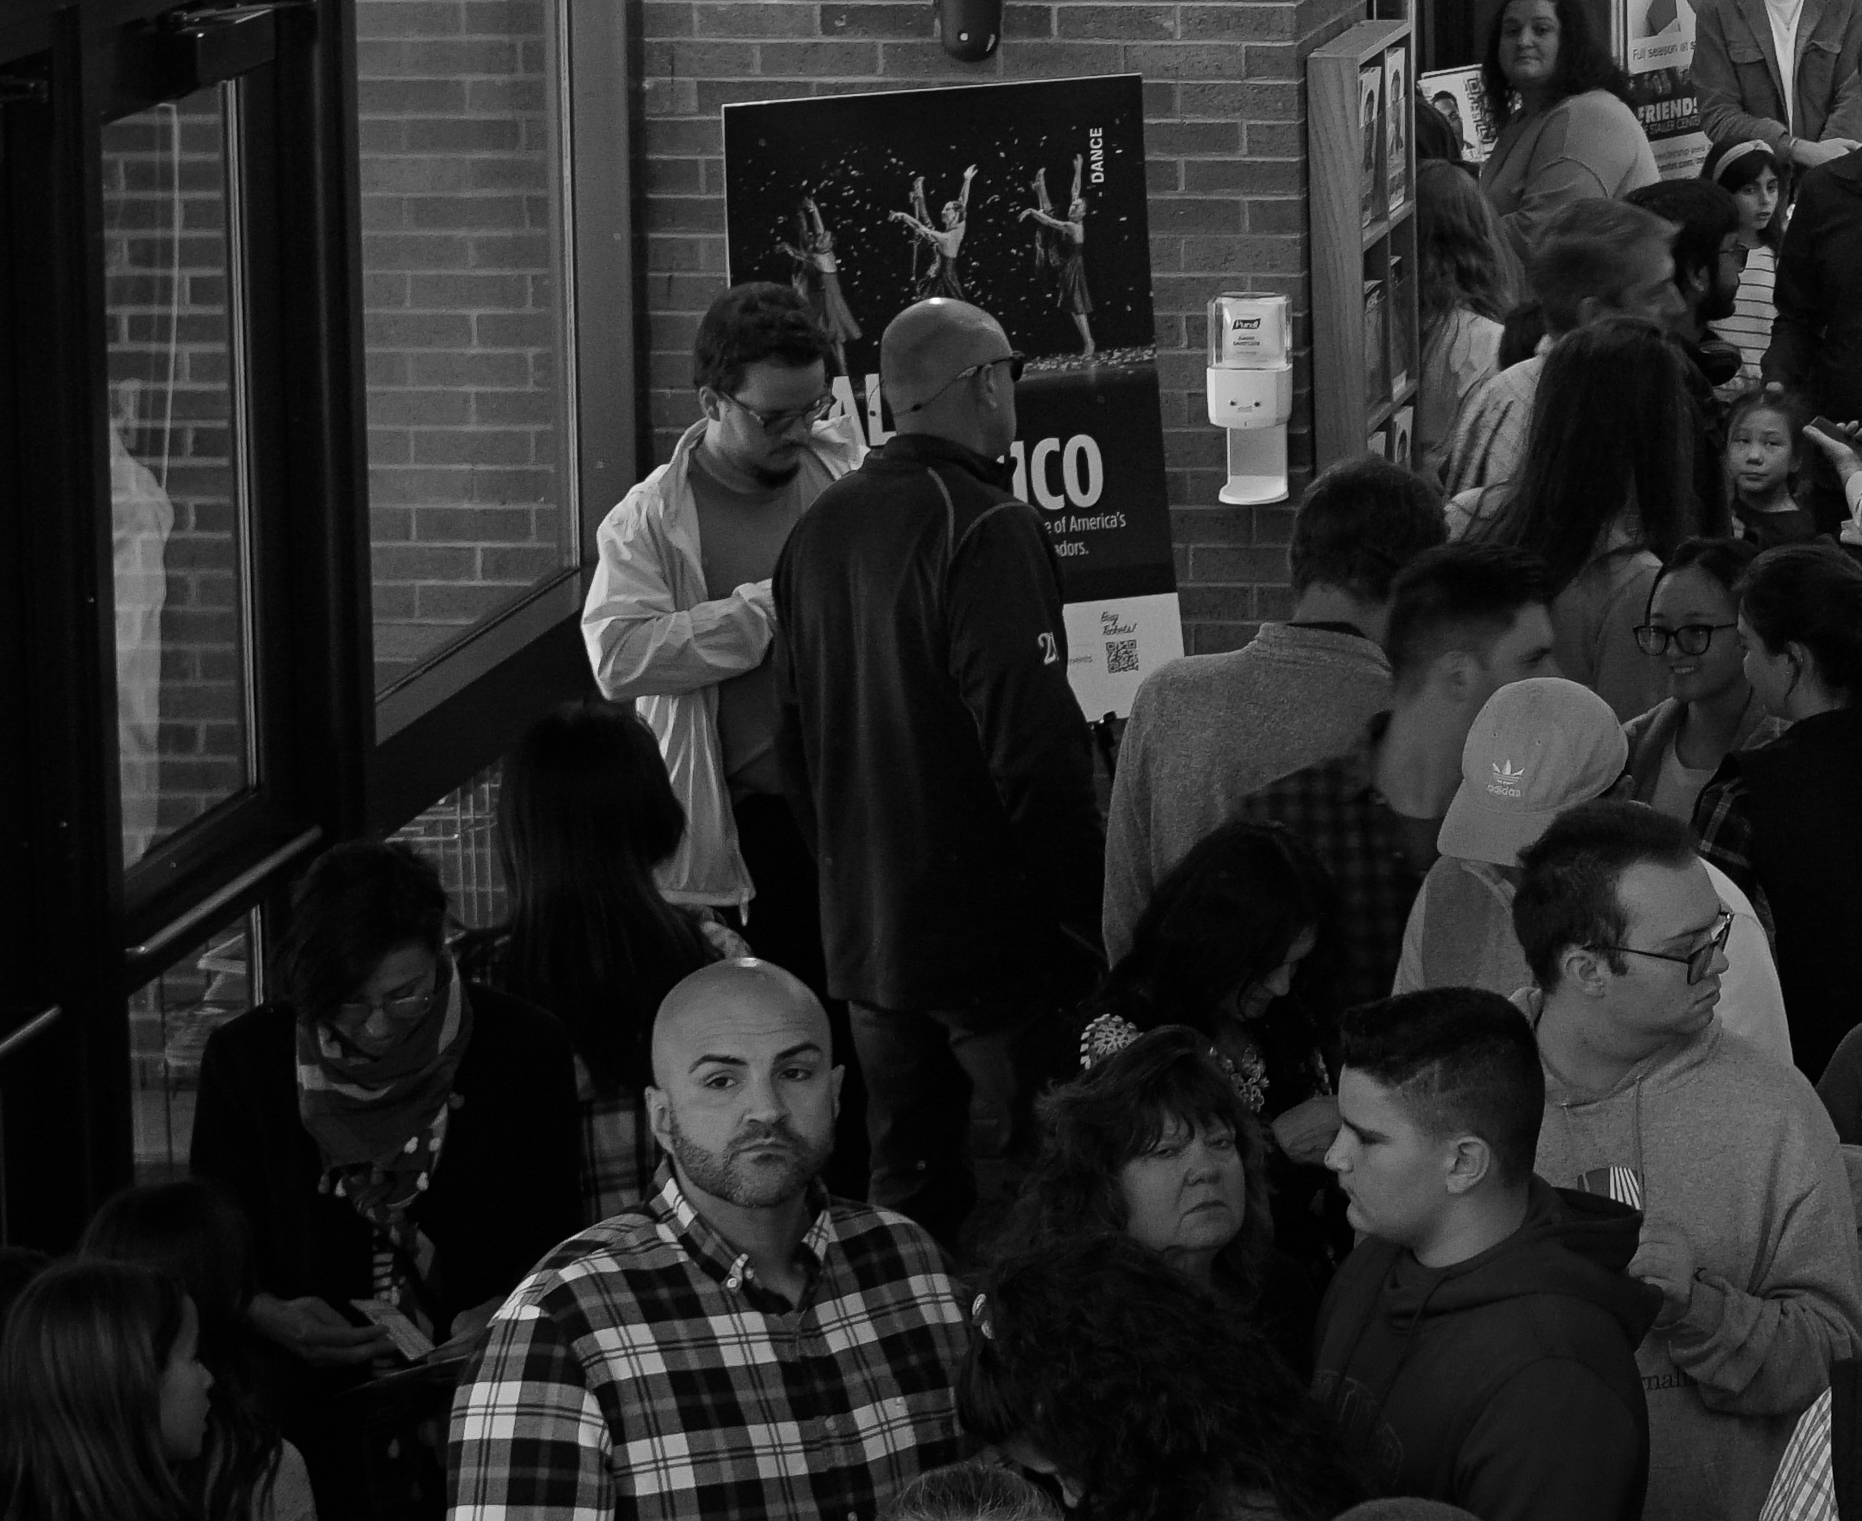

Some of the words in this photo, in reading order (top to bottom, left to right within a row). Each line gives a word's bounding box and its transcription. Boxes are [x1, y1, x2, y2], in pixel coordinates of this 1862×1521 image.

[1090, 126, 1103, 184] DANCE
[997, 433, 1104, 511] ICO
[1054, 515, 1066, 534] of
[1069, 511, 1127, 533] America's
